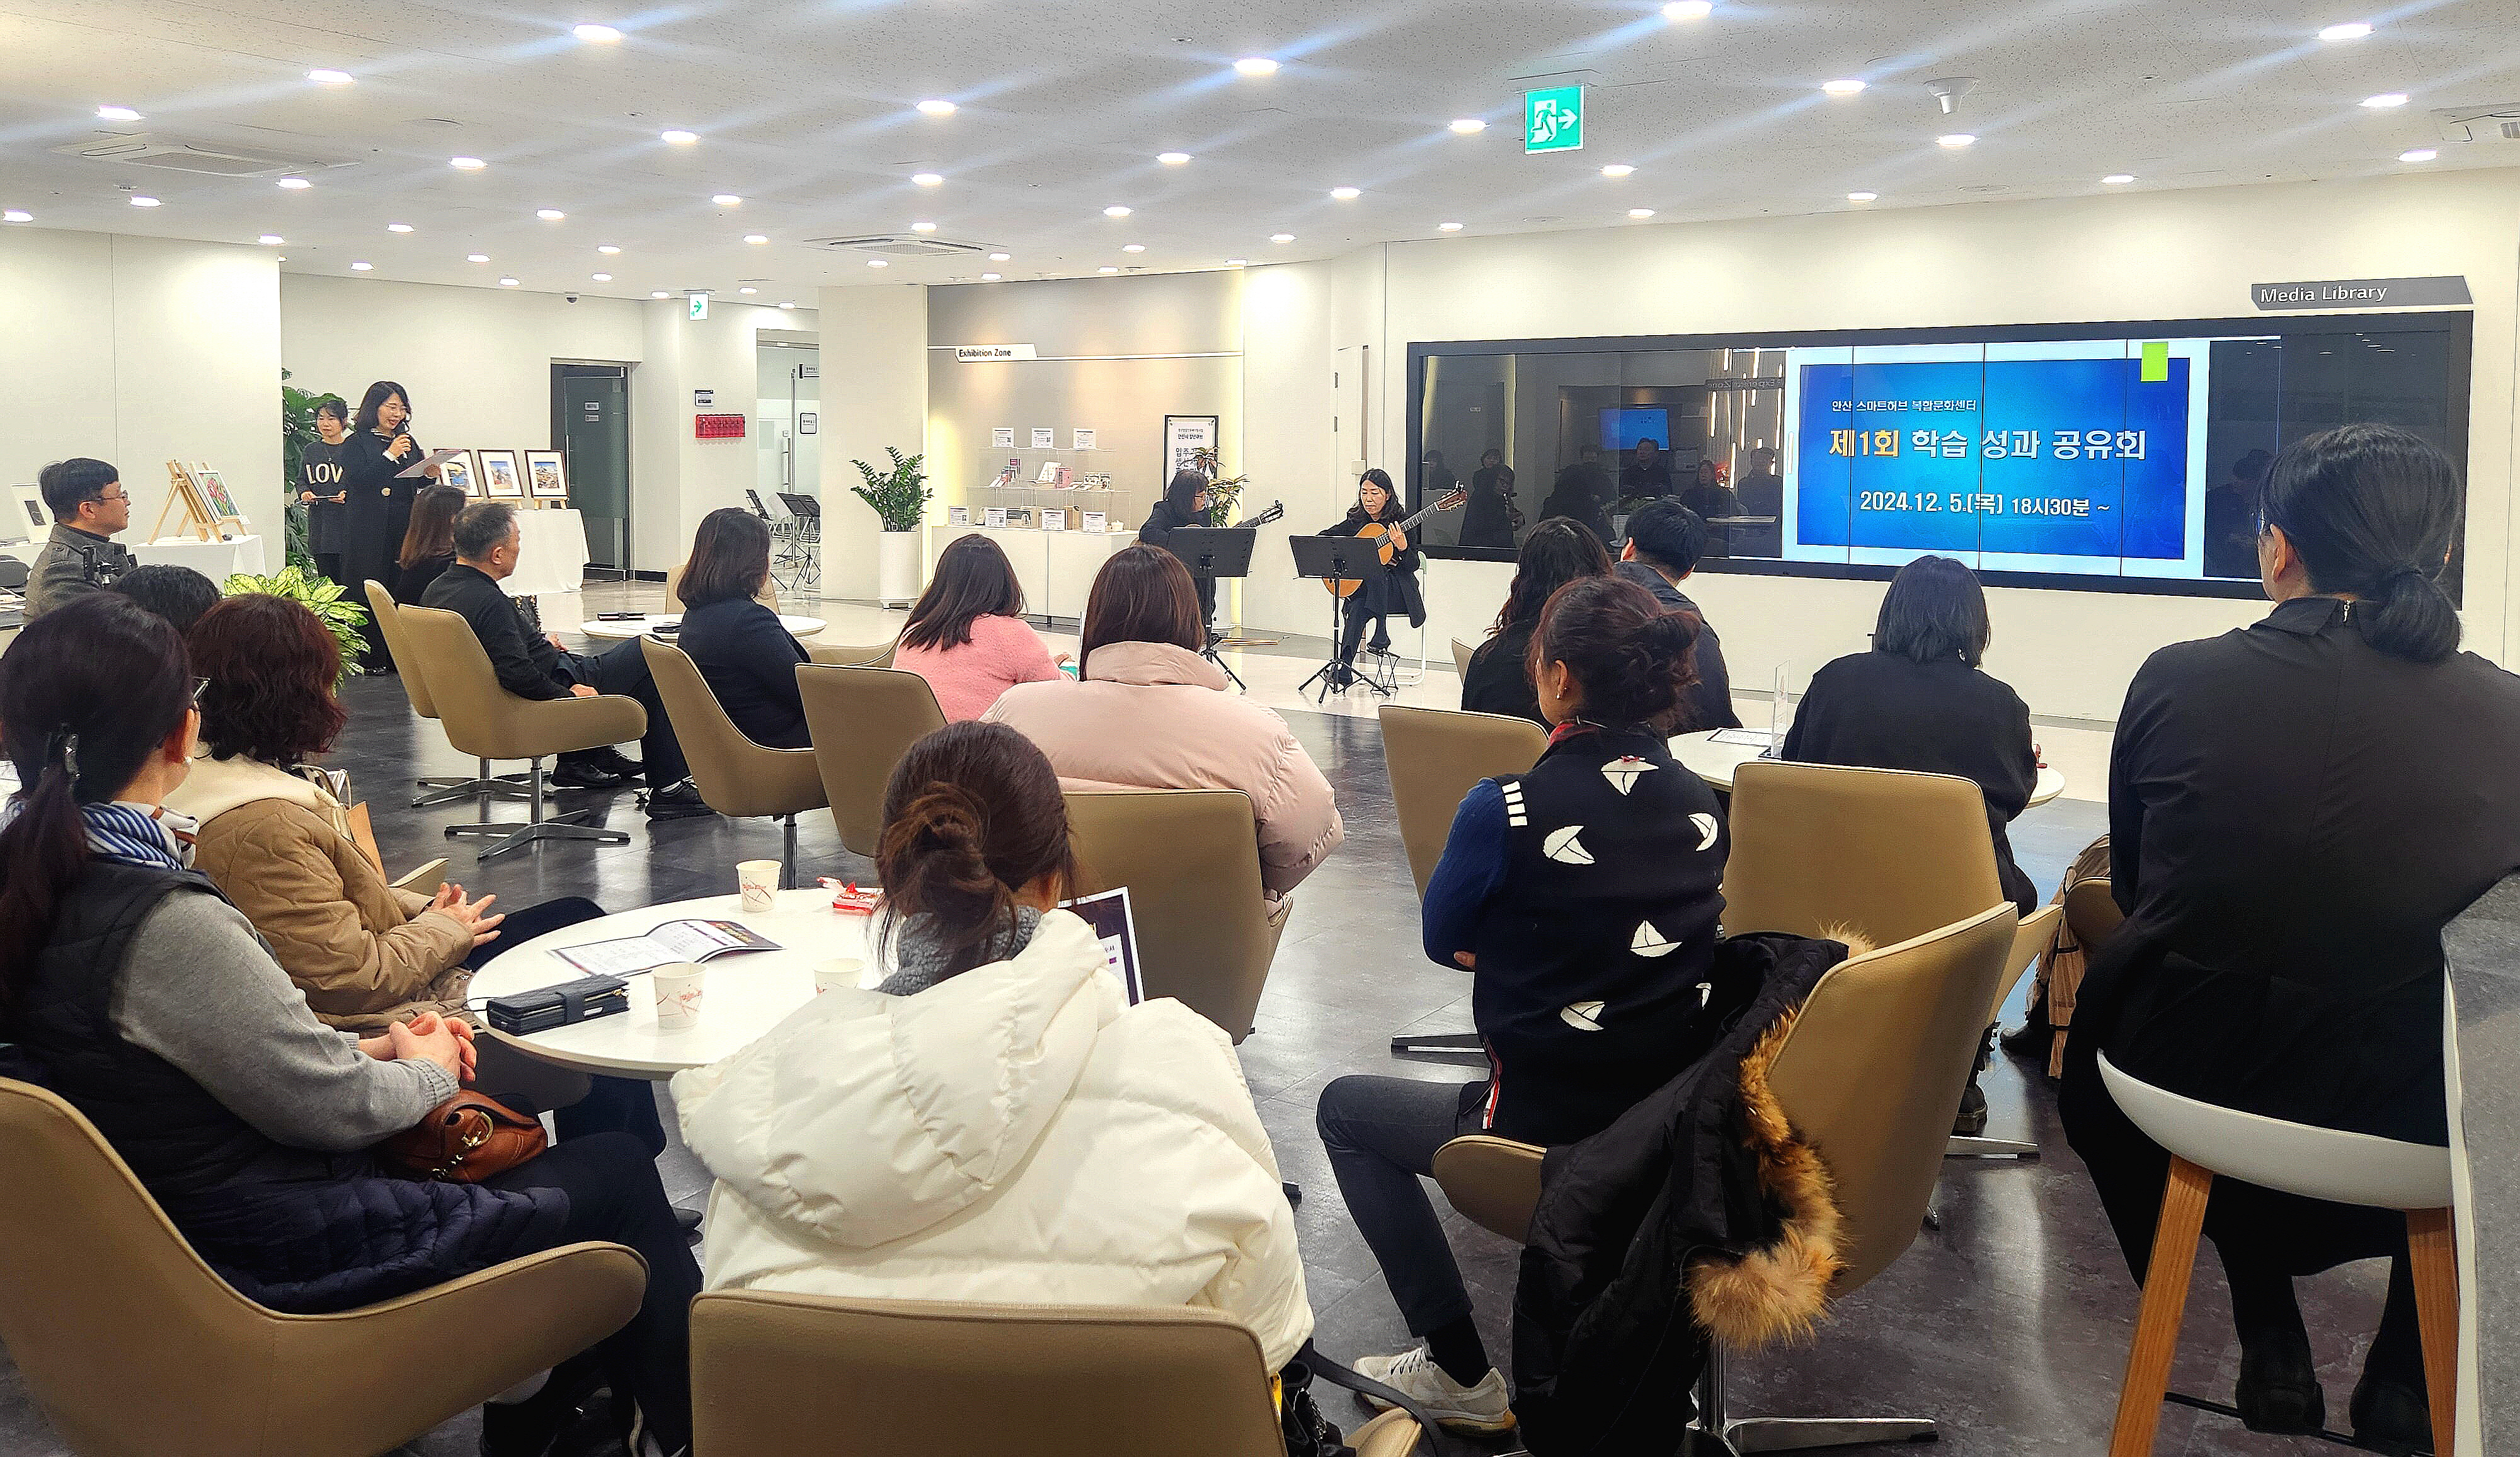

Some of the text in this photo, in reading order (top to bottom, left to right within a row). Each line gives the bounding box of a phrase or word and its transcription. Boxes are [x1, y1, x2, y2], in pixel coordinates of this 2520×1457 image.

[2260, 285, 2388, 302] Media Library
[959, 348, 1011, 357] Exhibition Zone
[1832, 399, 1977, 412] 안산 스마트허브 복합문화센터
[1829, 430, 2146, 460] 제1회 학습 성과 공유회
[1860, 491, 1942, 512] 2024.12.
[1950, 492, 2003, 515] 5.(목)
[2012, 497, 2090, 517] 18시30분
